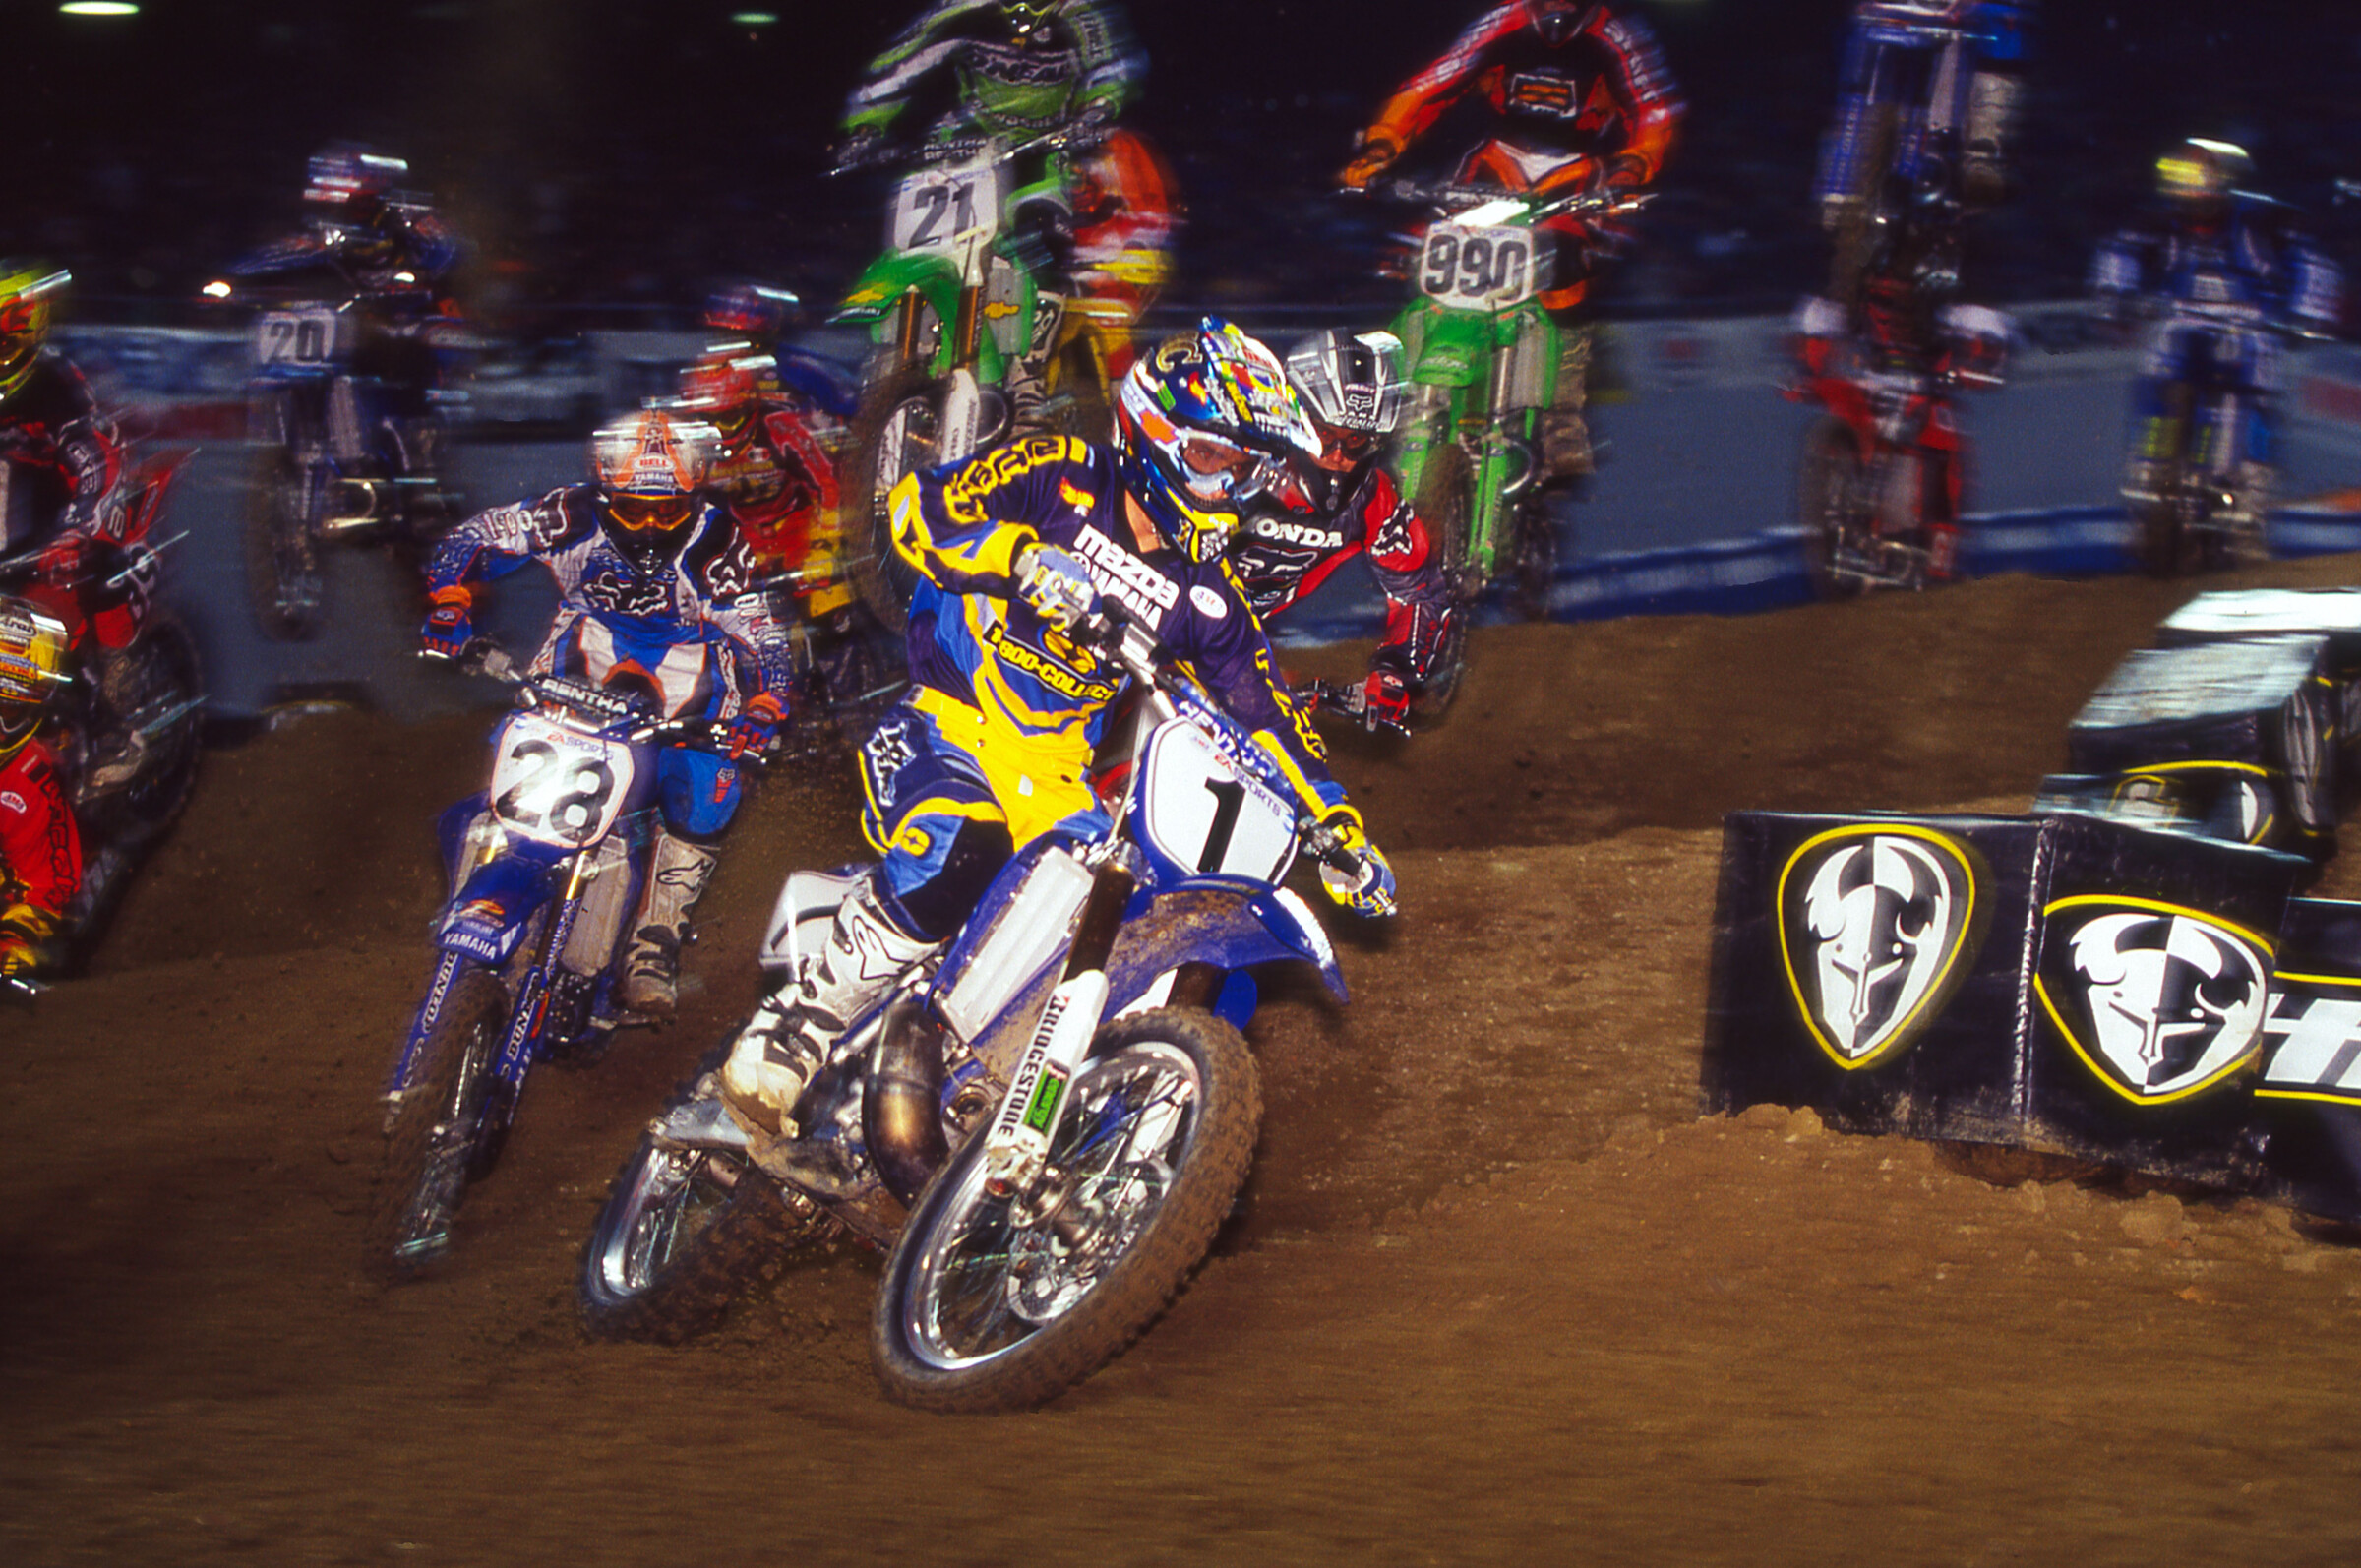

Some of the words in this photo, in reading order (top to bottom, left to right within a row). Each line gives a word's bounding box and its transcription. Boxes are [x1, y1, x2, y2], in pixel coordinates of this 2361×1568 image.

[909, 183, 974, 248] 21
[1426, 234, 1528, 300] 990
[268, 319, 325, 362] 20
[635, 472, 674, 483] YAMAHA
[1256, 517, 1343, 548] ONDA
[541, 678, 628, 715] RENTHA
[496, 739, 615, 843] 28
[1196, 776, 1246, 874] 1
[444, 933, 497, 960] YAMAHA
[998, 993, 1070, 1138] BRIDGESTONE
